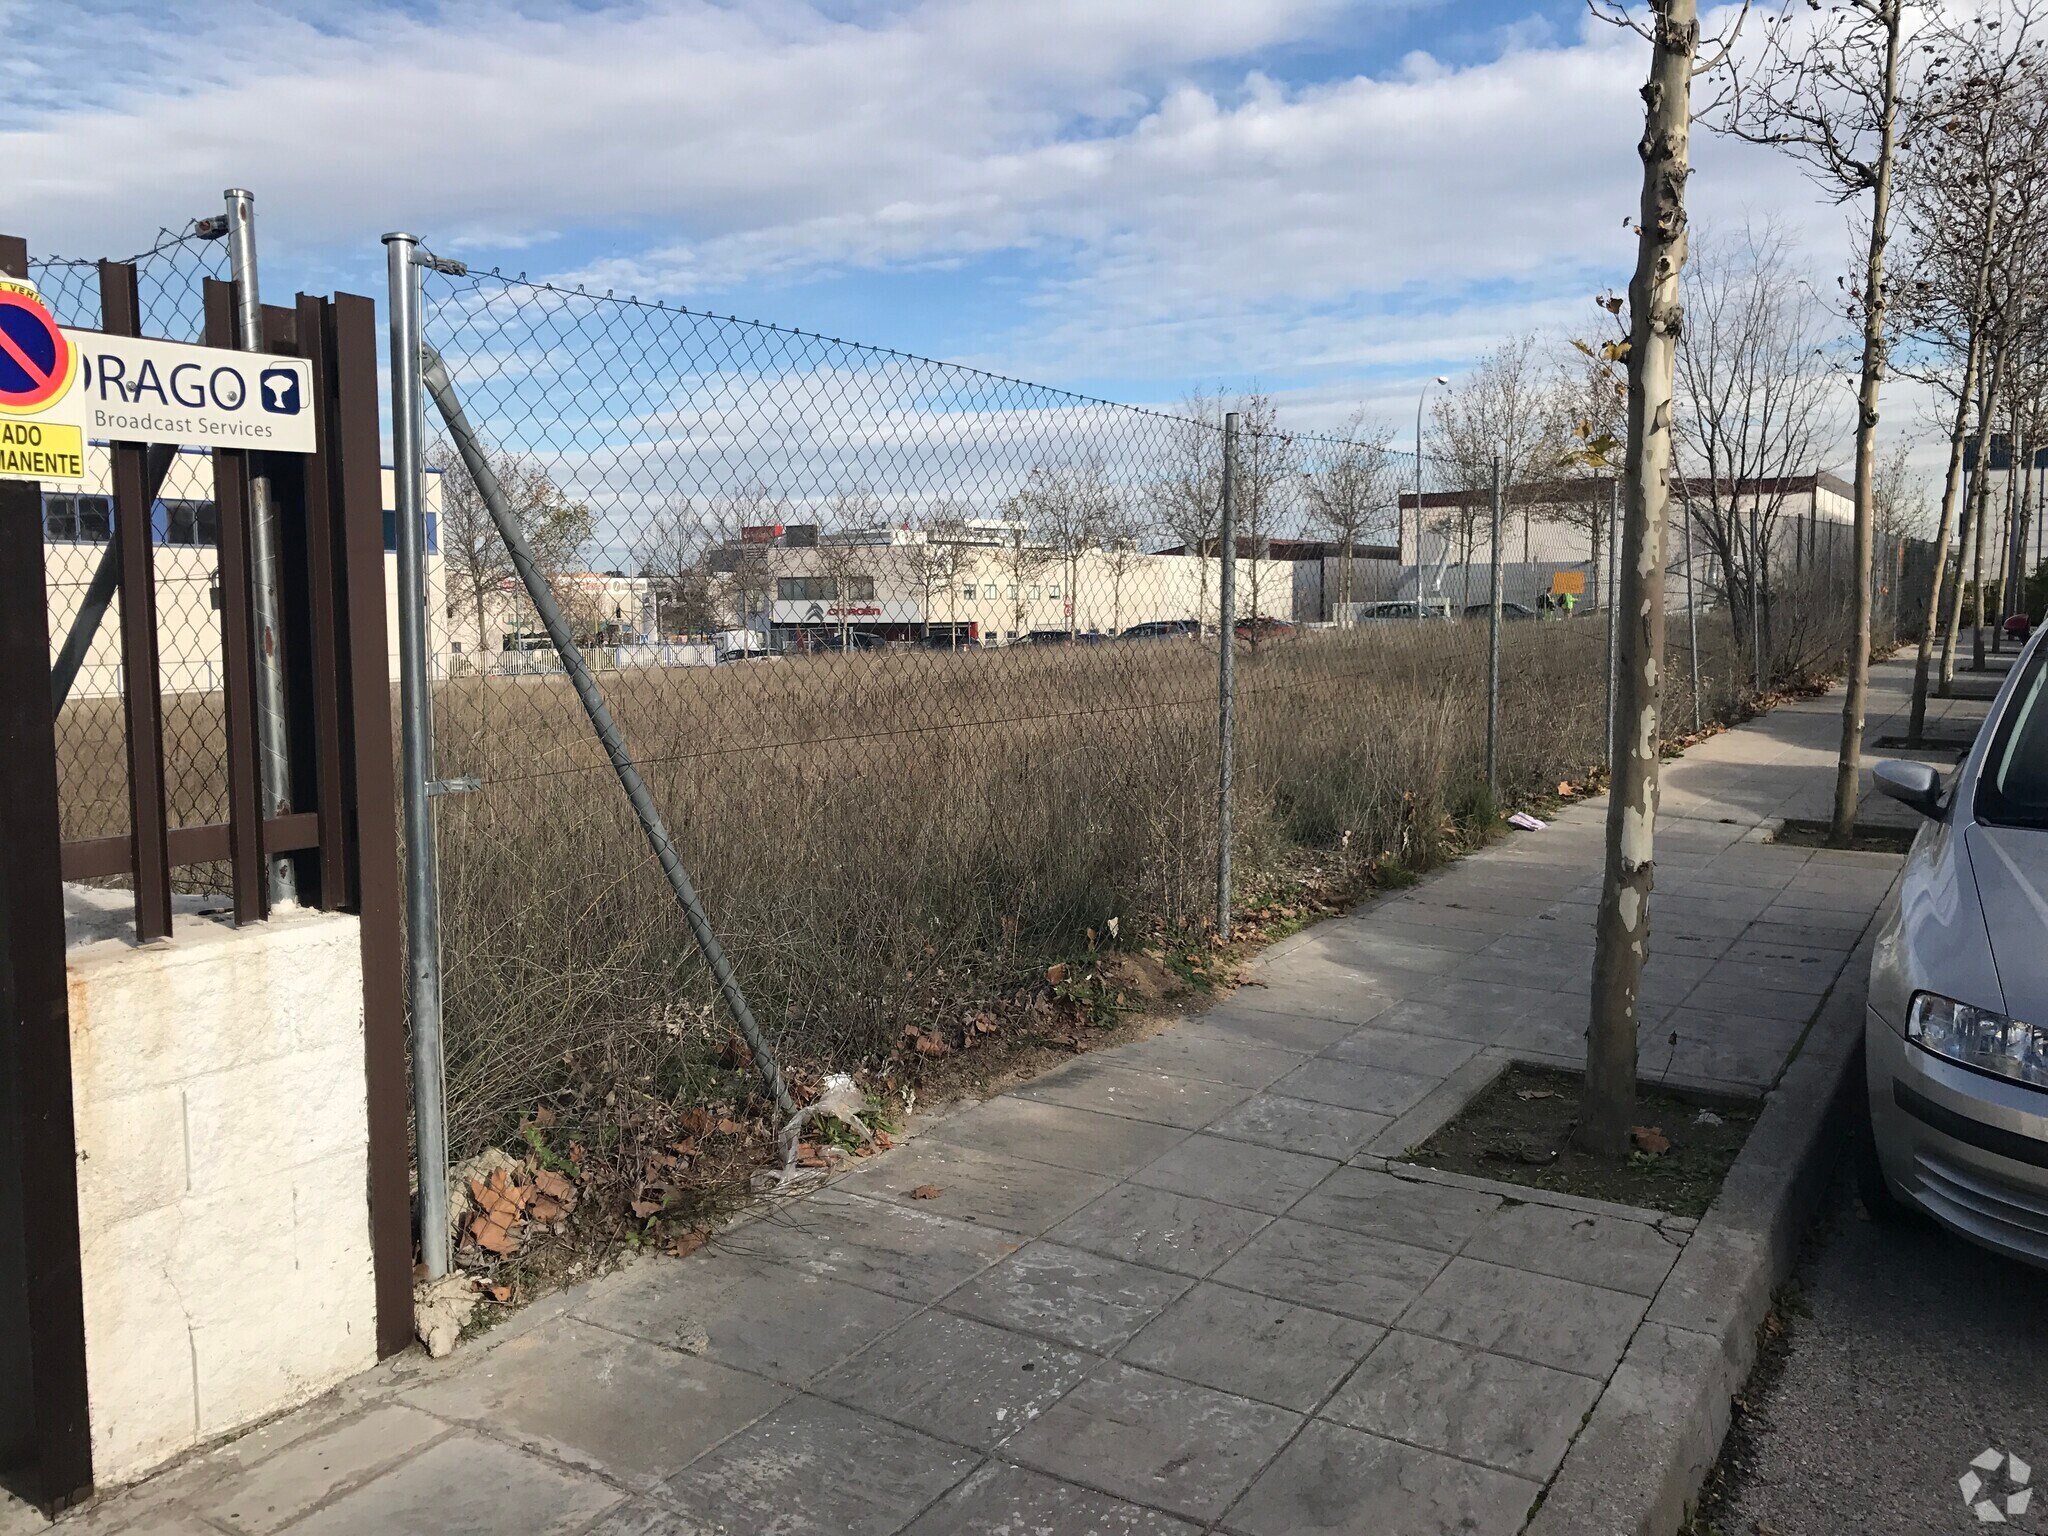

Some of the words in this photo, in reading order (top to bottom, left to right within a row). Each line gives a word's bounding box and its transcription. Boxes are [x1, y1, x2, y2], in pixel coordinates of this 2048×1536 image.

[2, 423, 42, 447] ADO
[95, 409, 192, 433] Broadcast
[198, 417, 273, 438] Services
